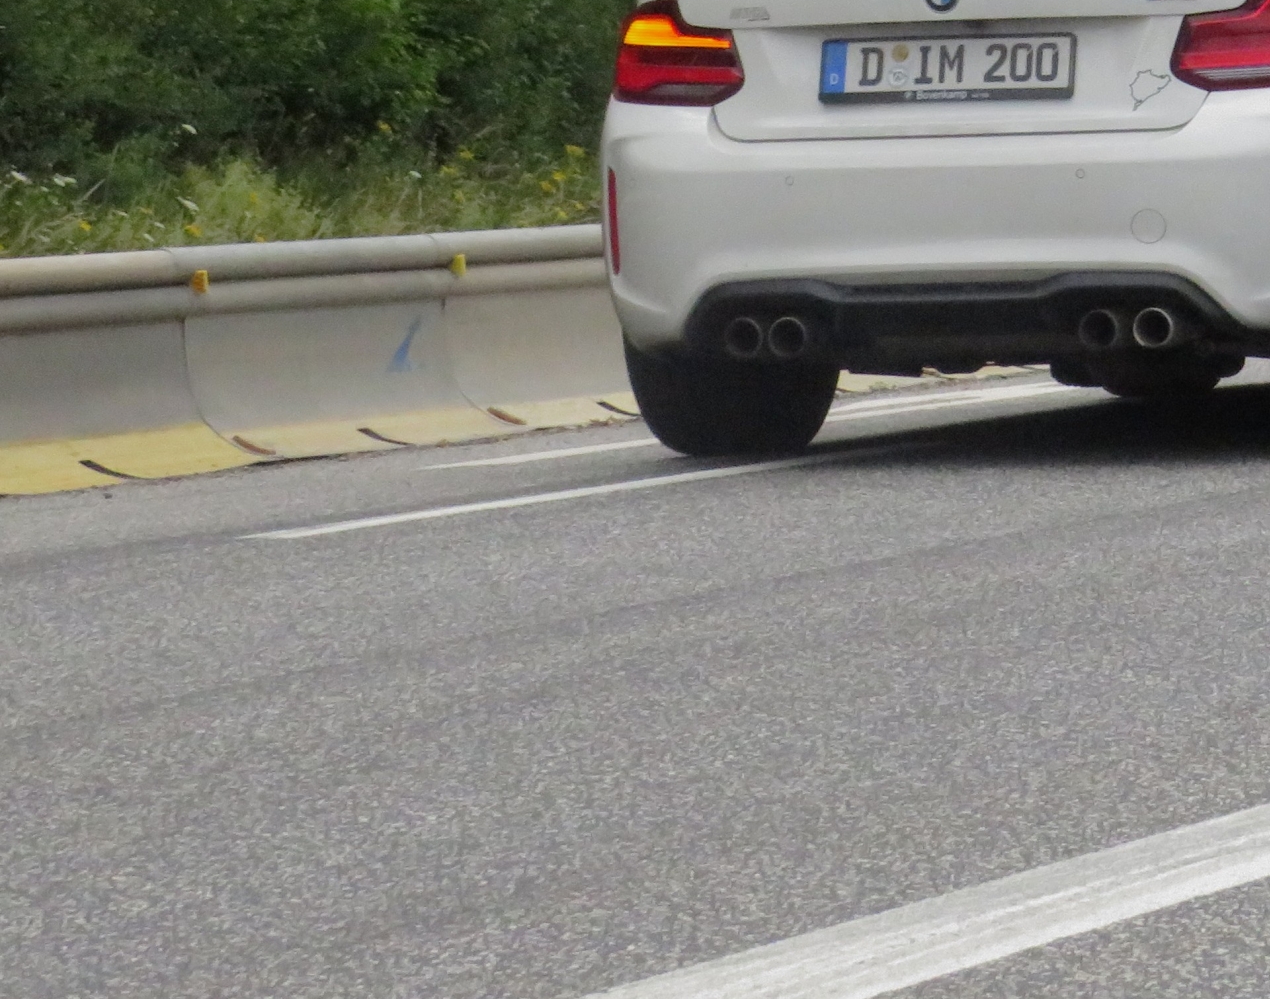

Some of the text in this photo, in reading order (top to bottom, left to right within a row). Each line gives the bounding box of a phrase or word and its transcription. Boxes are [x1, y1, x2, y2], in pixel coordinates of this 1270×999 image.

[859, 42, 1060, 86] D IM 200
[830, 73, 839, 85] D
